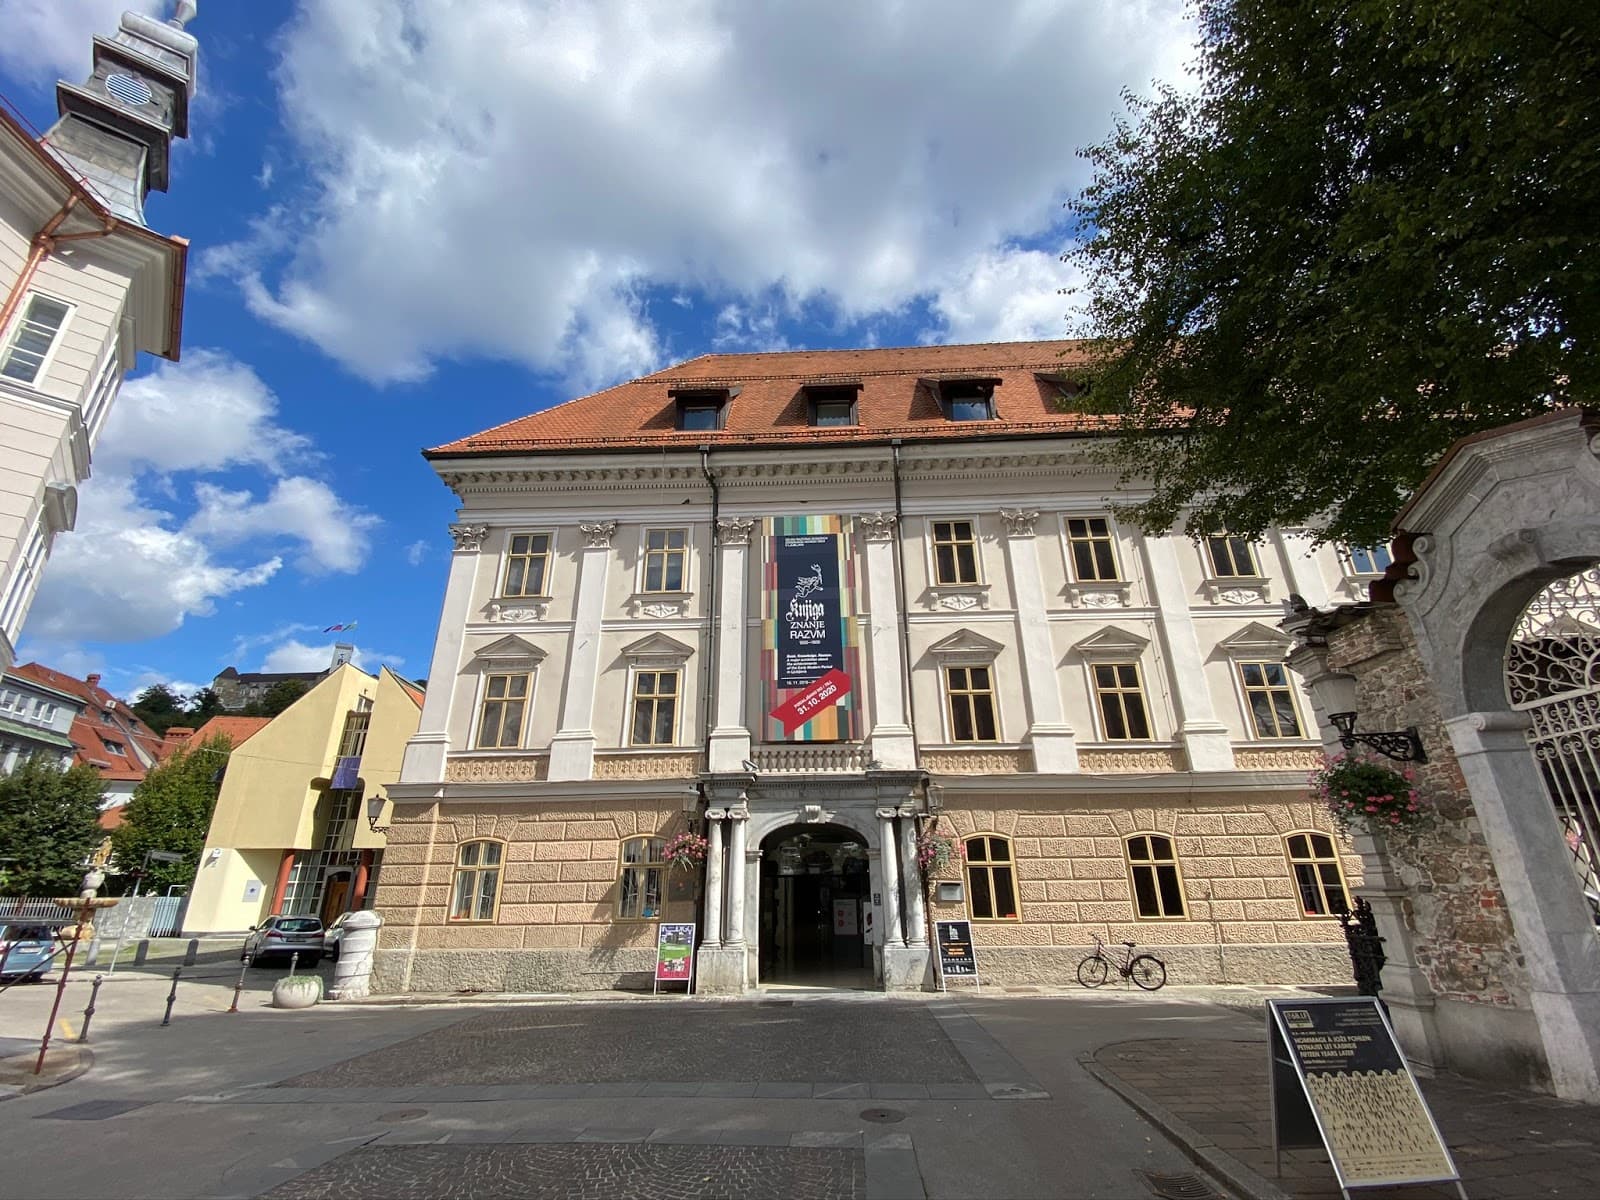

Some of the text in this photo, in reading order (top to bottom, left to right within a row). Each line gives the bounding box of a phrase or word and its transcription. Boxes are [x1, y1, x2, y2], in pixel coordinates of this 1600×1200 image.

[786, 598, 824, 621] Knjiga
[790, 621, 825, 630] ZNANJE
[790, 630, 826, 639] RAZVM
[797, 684, 837, 715] 31. 10. 2020
